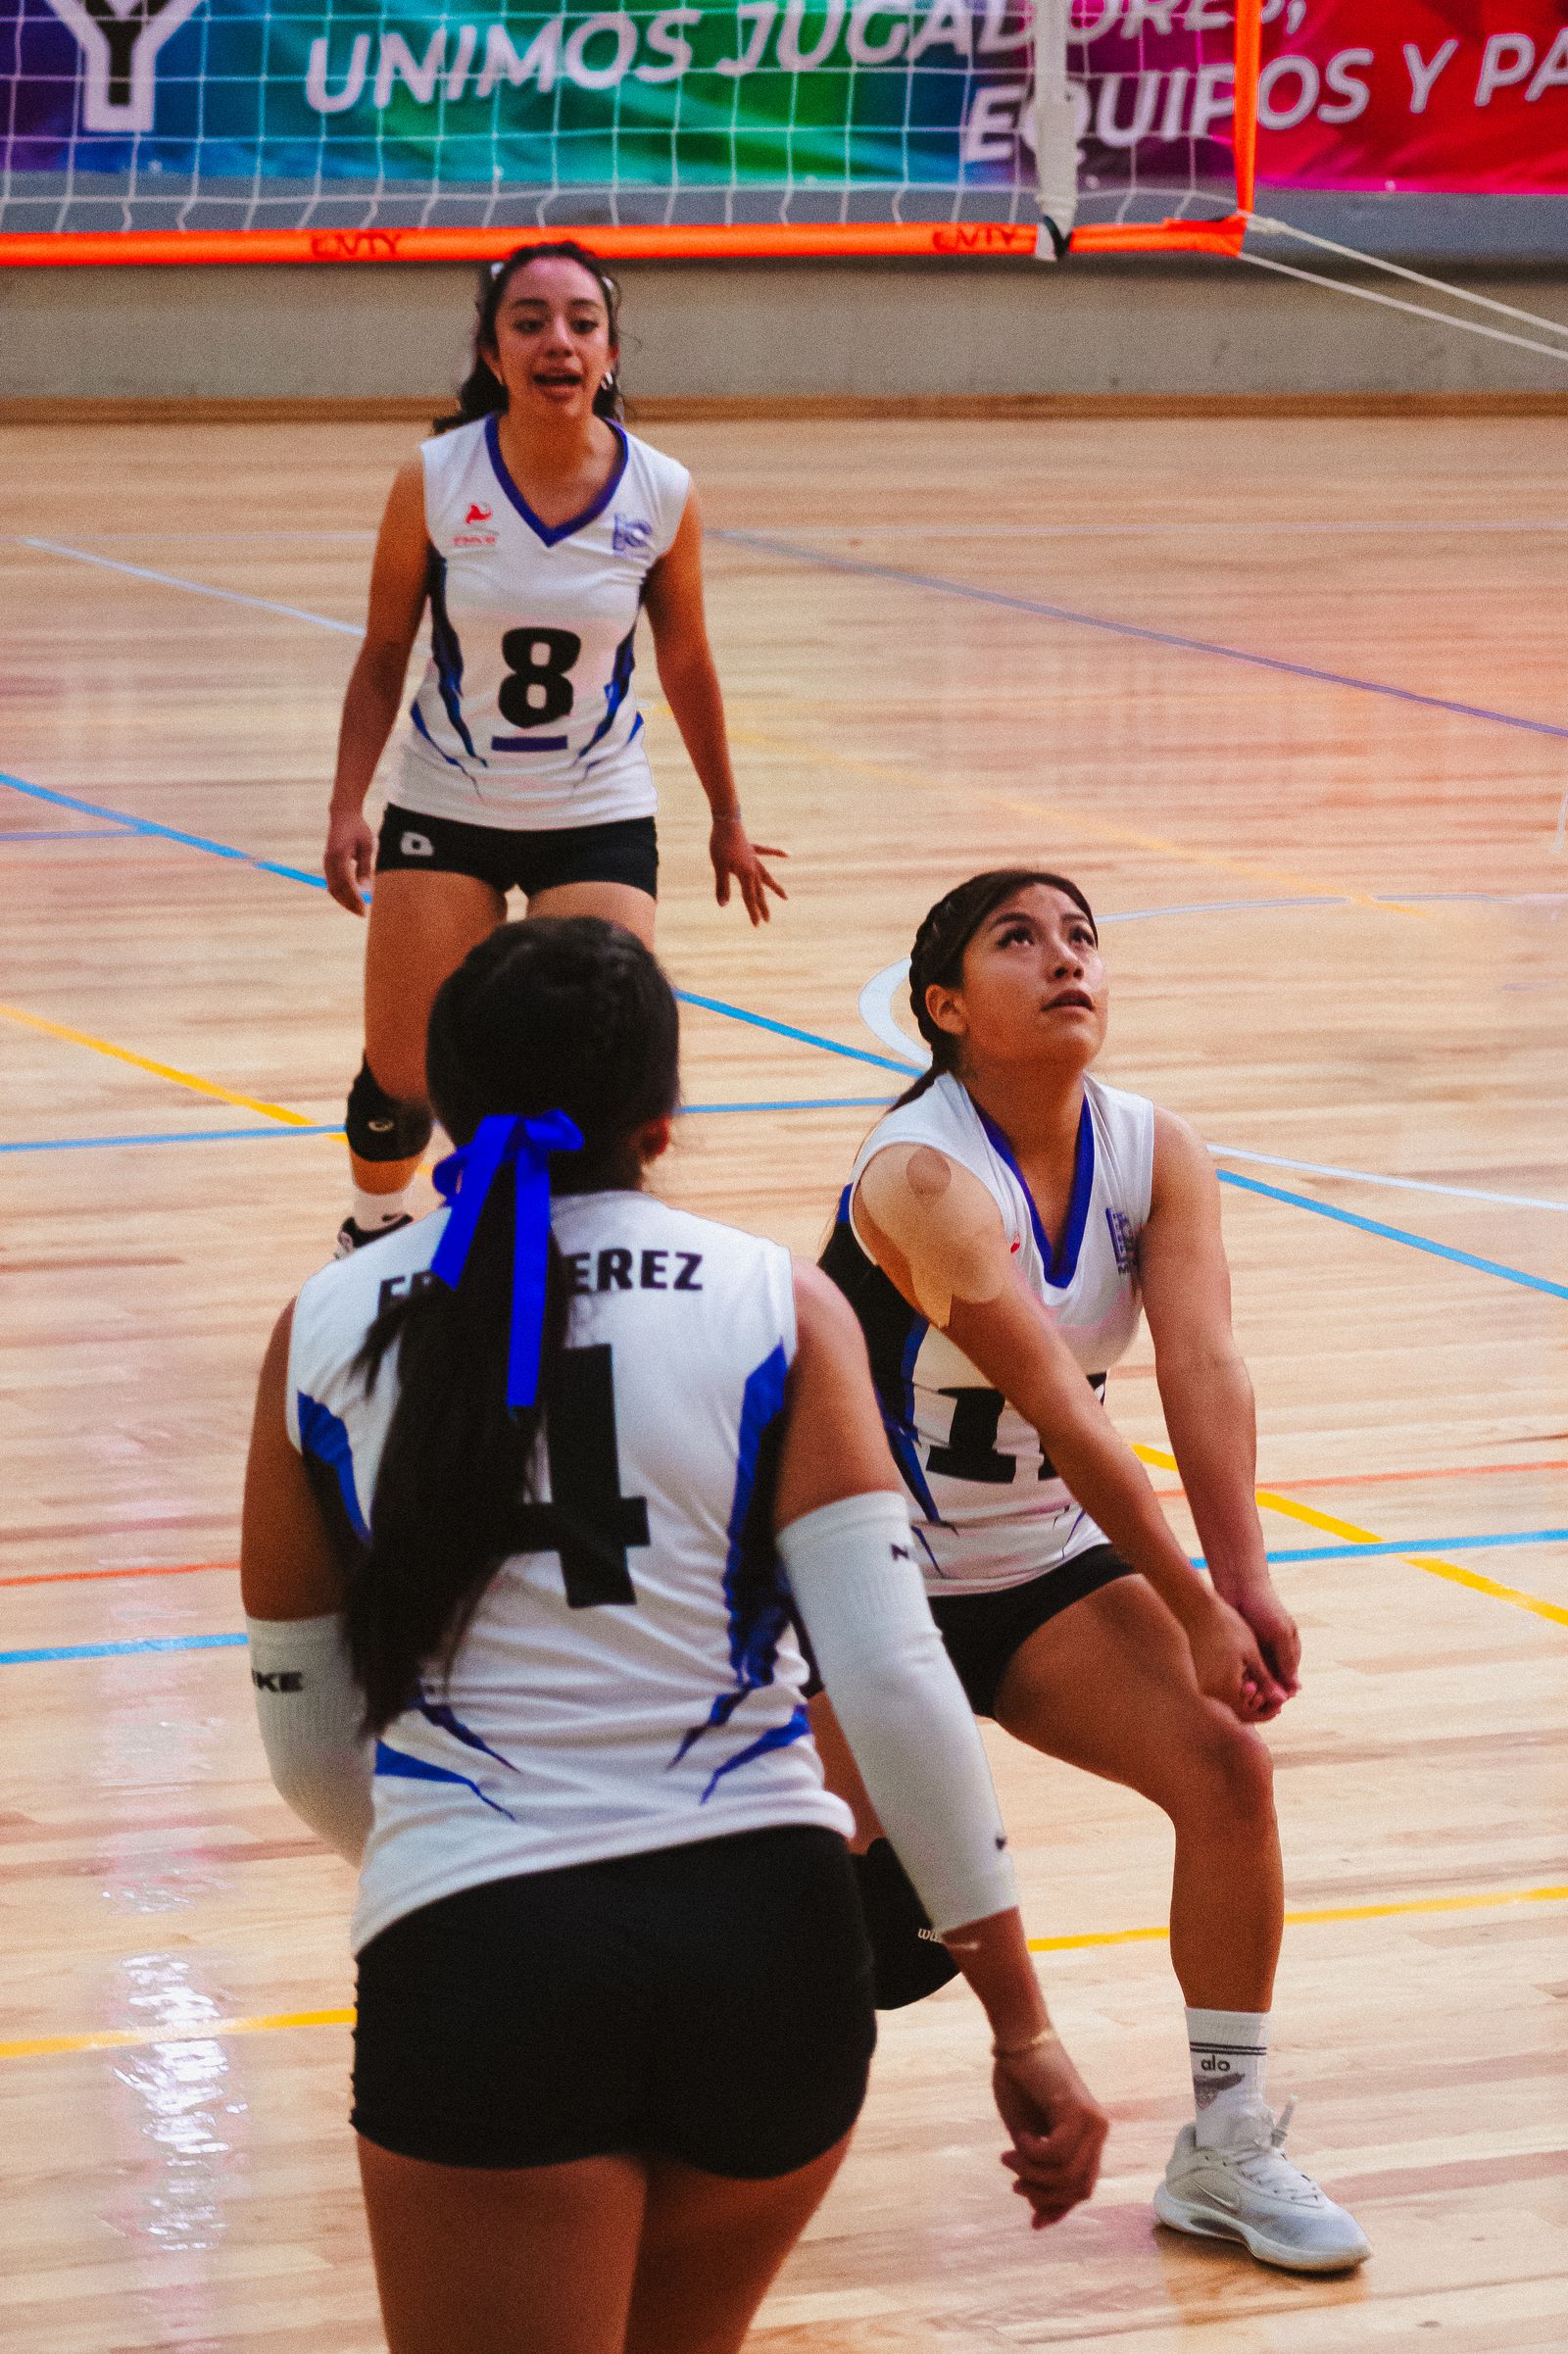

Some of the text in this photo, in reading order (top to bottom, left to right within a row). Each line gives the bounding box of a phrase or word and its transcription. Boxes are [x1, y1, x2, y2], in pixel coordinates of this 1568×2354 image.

[305, 8, 703, 115] UNIMOS
[1402, 38, 1459, 114] Y
[1474, 26, 1568, 107] PA
[497, 627, 581, 729] 8
[505, 1344, 651, 1608] 4
[1200, 2054, 1231, 2072] alo
